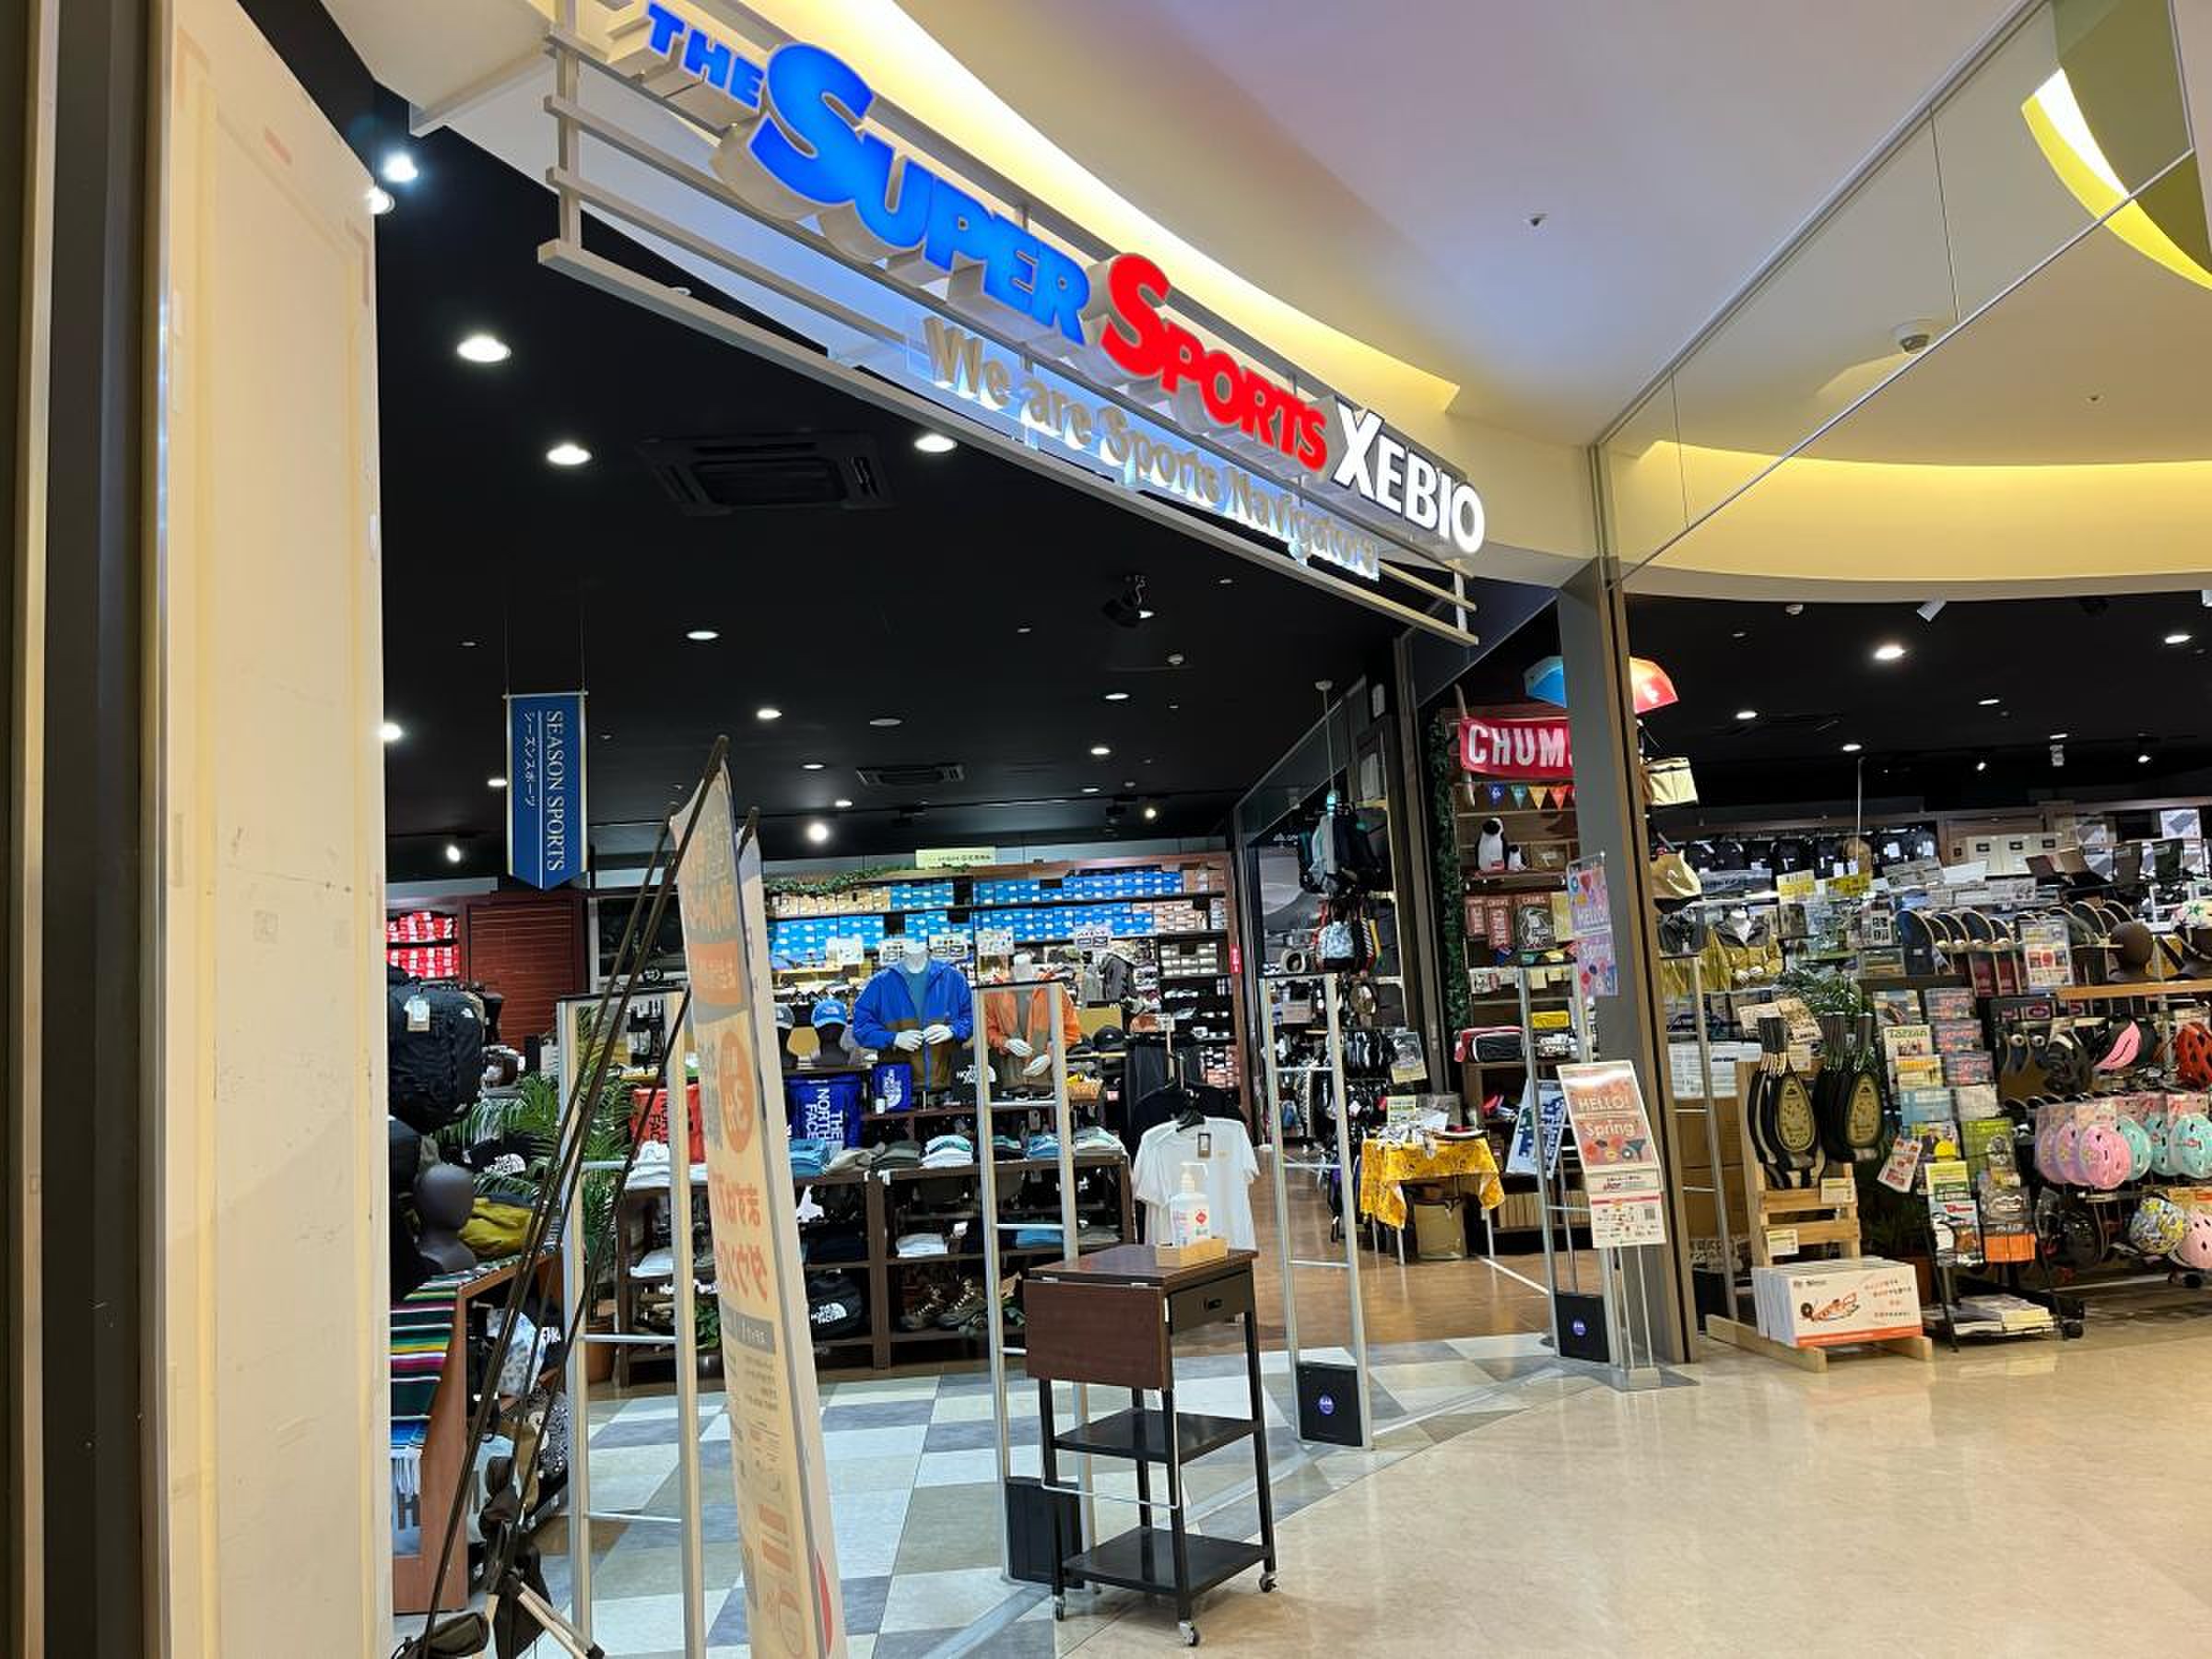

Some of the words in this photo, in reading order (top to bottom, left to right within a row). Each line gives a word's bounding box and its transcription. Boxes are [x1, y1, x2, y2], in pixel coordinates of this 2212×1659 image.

[645, 4, 765, 112] THE
[747, 41, 1091, 346] SUPER
[1100, 253, 1328, 472] SPORTS
[1332, 401, 1487, 554] XEBIO
[924, 316, 1012, 411] We
[1020, 376, 1093, 452] are
[1099, 406, 1222, 509] Sports
[1222, 465, 1381, 582] Navigators
[546, 710, 566, 790] SEASON
[1468, 724, 1572, 768] CHUM
[546, 795, 566, 871] SPORTS
[816, 1088, 830, 1140] NORTH
[830, 1109, 843, 1141] THE
[1577, 1093, 1632, 1112] HELLO!
[648, 1113, 661, 1142] FAC
[1584, 1120, 1638, 1140] Spring
